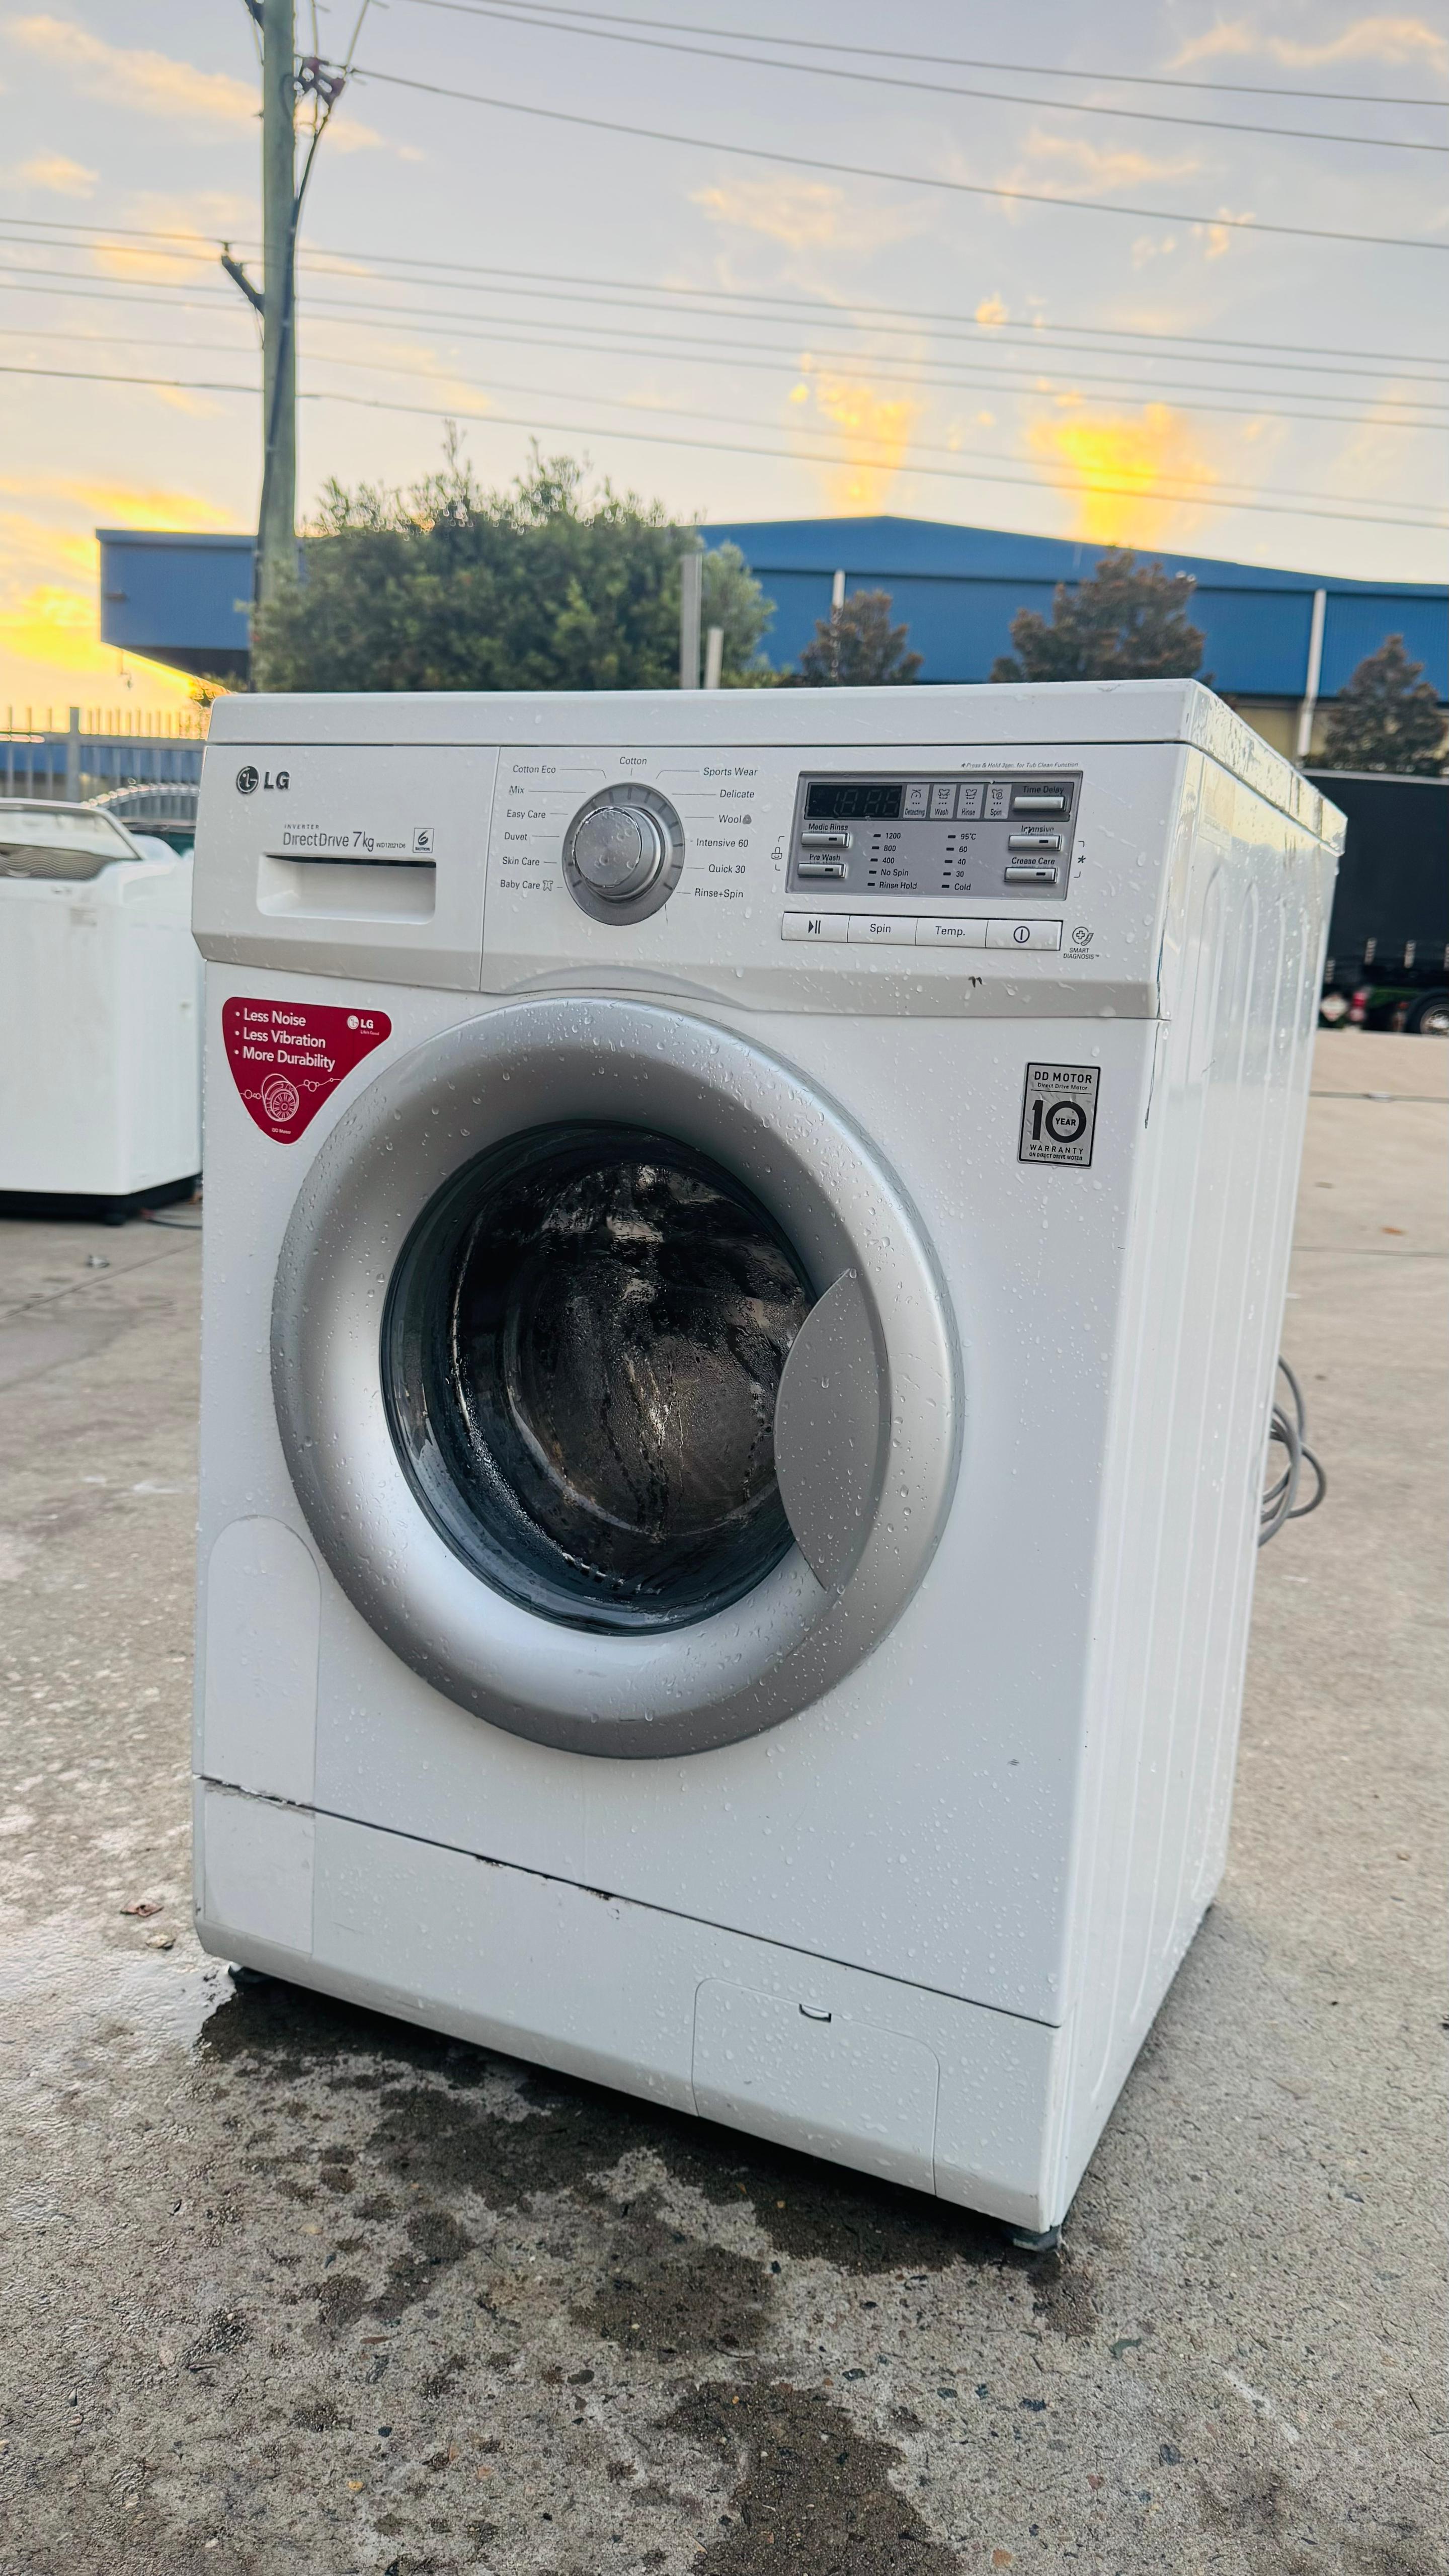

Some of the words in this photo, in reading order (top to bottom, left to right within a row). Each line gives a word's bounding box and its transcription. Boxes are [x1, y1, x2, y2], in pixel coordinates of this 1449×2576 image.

[620, 756, 647, 765] Cotton
[513, 765, 539, 774] Cotton
[541, 766, 556, 774] Eco
[703, 767, 732, 777] Sports
[735, 767, 758, 776] Wear
[264, 771, 290, 790] LG
[509, 785, 525, 795] Mix
[719, 789, 755, 798] Delicate
[1043, 786, 1064, 794] Delay
[507, 810, 526, 821] Easy
[528, 810, 546, 819] Care
[990, 809, 1002, 817] Spin
[719, 815, 742, 824] Wool
[504, 832, 527, 841] Duvet
[696, 838, 736, 847] Intensive
[738, 839, 749, 848] 60
[502, 857, 519, 866] Skin
[521, 857, 540, 866] Care
[708, 864, 734, 874] Quick
[735, 865, 746, 874] 30
[893, 869, 909, 877] Spin
[500, 880, 520, 891] Baby
[522, 881, 540, 890] Care
[695, 889, 744, 899] Rinse+Spin
[870, 923, 891, 935] Spin
[935, 926, 965, 939] Temp.
[244, 1007, 269, 1022] Less
[272, 1010, 306, 1026] Noise
[360, 1019, 374, 1029] LG
[243, 1027, 268, 1042] Less
[271, 1029, 326, 1049] Vibration
[243, 1046, 274, 1062] More
[277, 1050, 336, 1073] Durability
[1034, 1071, 1049, 1080] DD
[1053, 1072, 1092, 1083] MOTOR
[1032, 1099, 1087, 1143] 10
[1056, 1117, 1076, 1126] YEAR
[1030, 1144, 1083, 1154] WARRANTY
